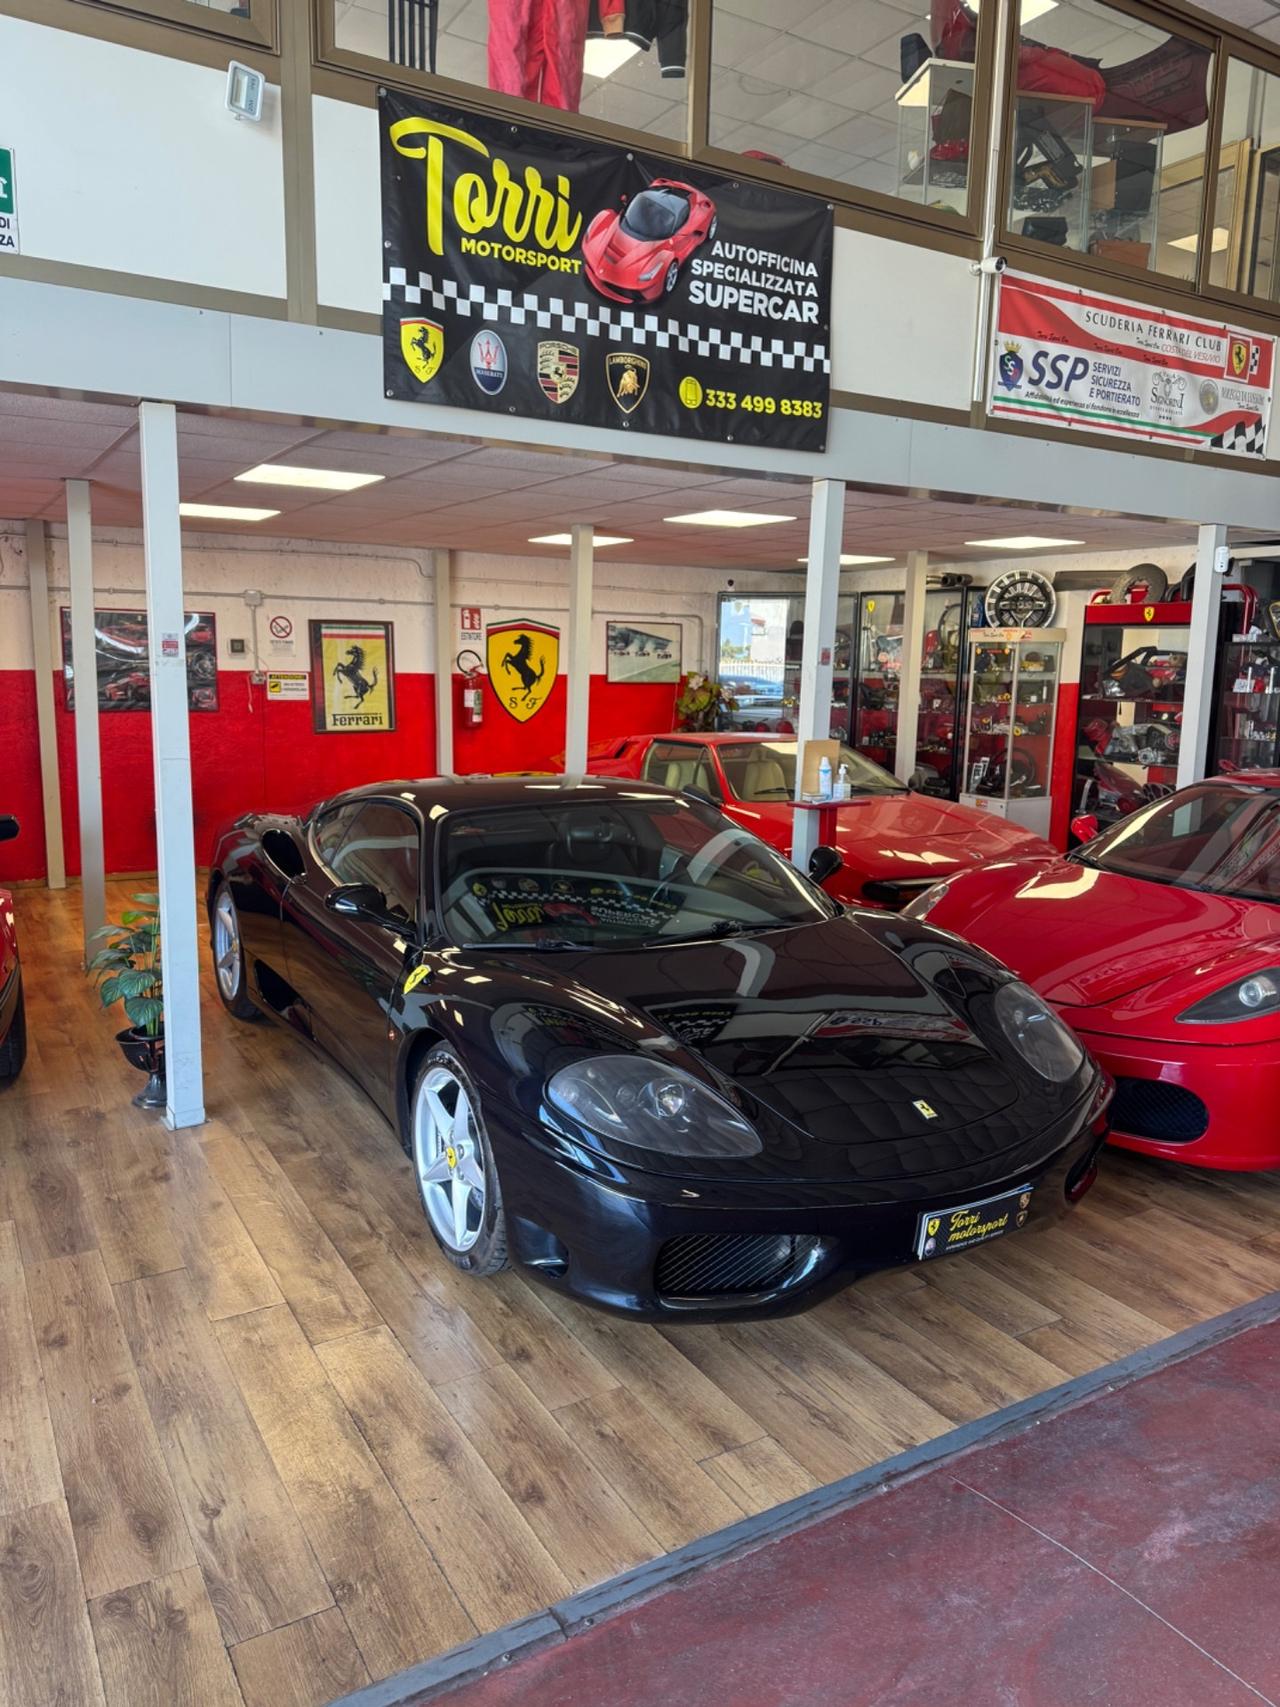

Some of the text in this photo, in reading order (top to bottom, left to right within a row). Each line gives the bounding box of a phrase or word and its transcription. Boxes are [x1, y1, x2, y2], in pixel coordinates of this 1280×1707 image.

[389, 116, 583, 255] Torri
[461, 237, 582, 274] MOTORSPORT
[711, 241, 818, 278] AUTOFFICINA
[691, 259, 818, 298] SPECIALIZZATA
[688, 280, 819, 324] SUPERCAR
[1086, 311, 1143, 334] SCUDERIA
[1148, 325, 1190, 345] FERRARI
[1195, 334, 1222, 351] CLUB
[1028, 350, 1089, 392] SSP
[1091, 374, 1132, 393] SICUREZZA
[1092, 361, 1121, 377] SERVIZI
[705, 388, 823, 418] 333 499 8383
[1089, 387, 1141, 407] E PORTIERATO
[331, 713, 383, 726] Ferrari
[948, 1213, 1009, 1242] motorsport
[950, 1210, 980, 1231] Torri
